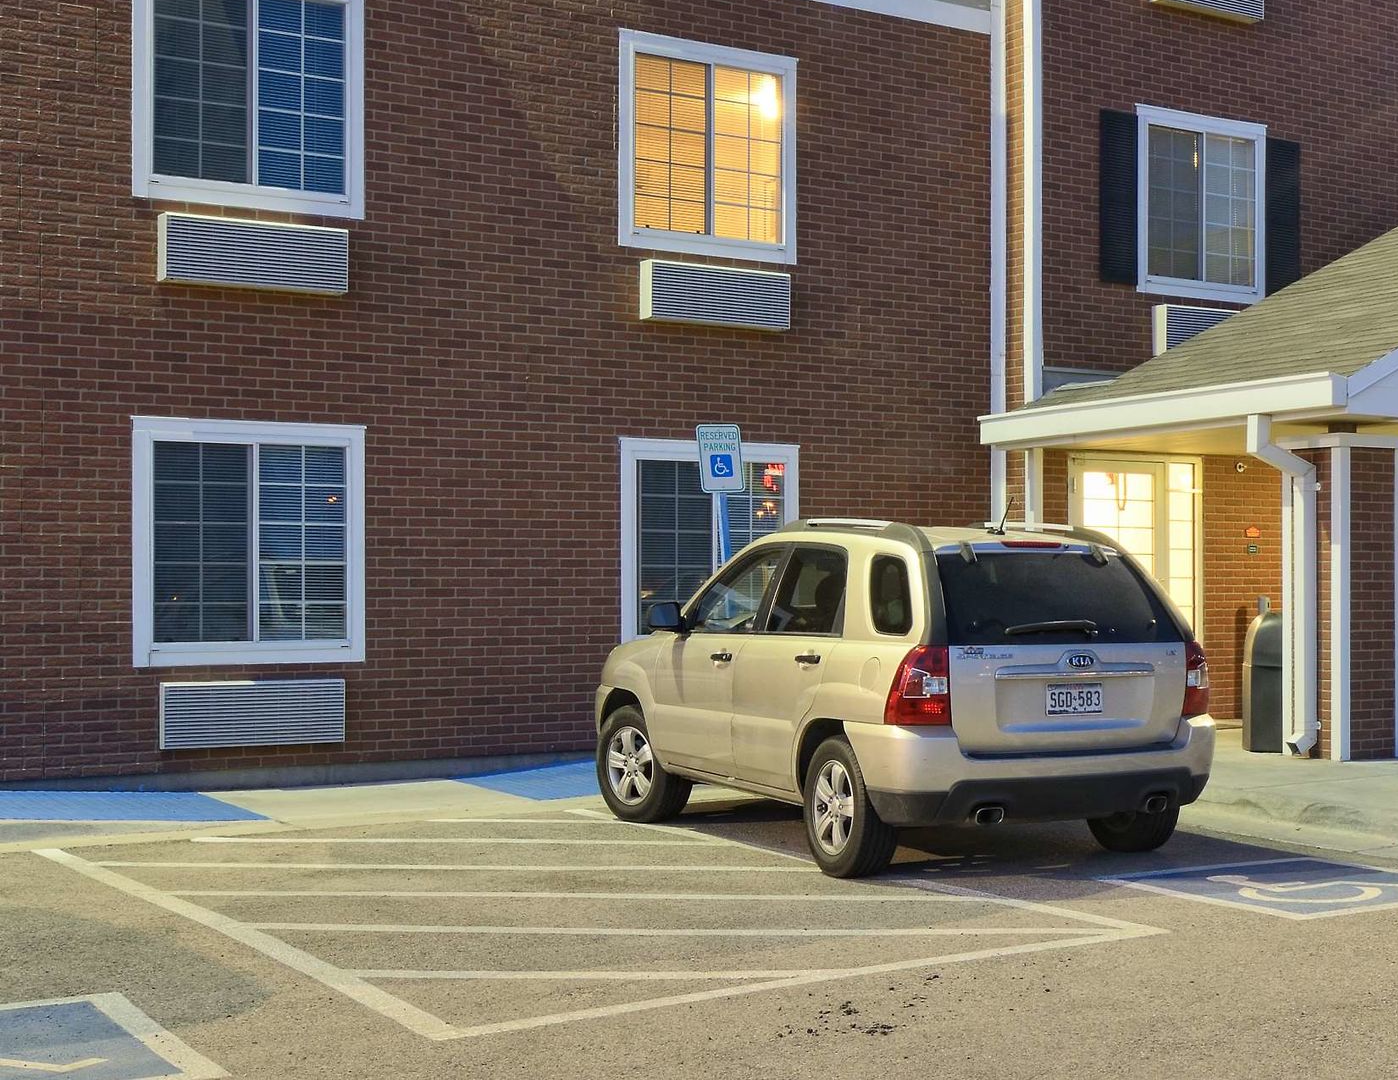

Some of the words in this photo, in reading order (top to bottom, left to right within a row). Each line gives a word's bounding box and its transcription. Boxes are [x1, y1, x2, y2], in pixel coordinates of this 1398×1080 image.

[700, 431, 737, 440] RESERVED
[703, 443, 736, 451] PARKING
[1071, 656, 1092, 666] KIA
